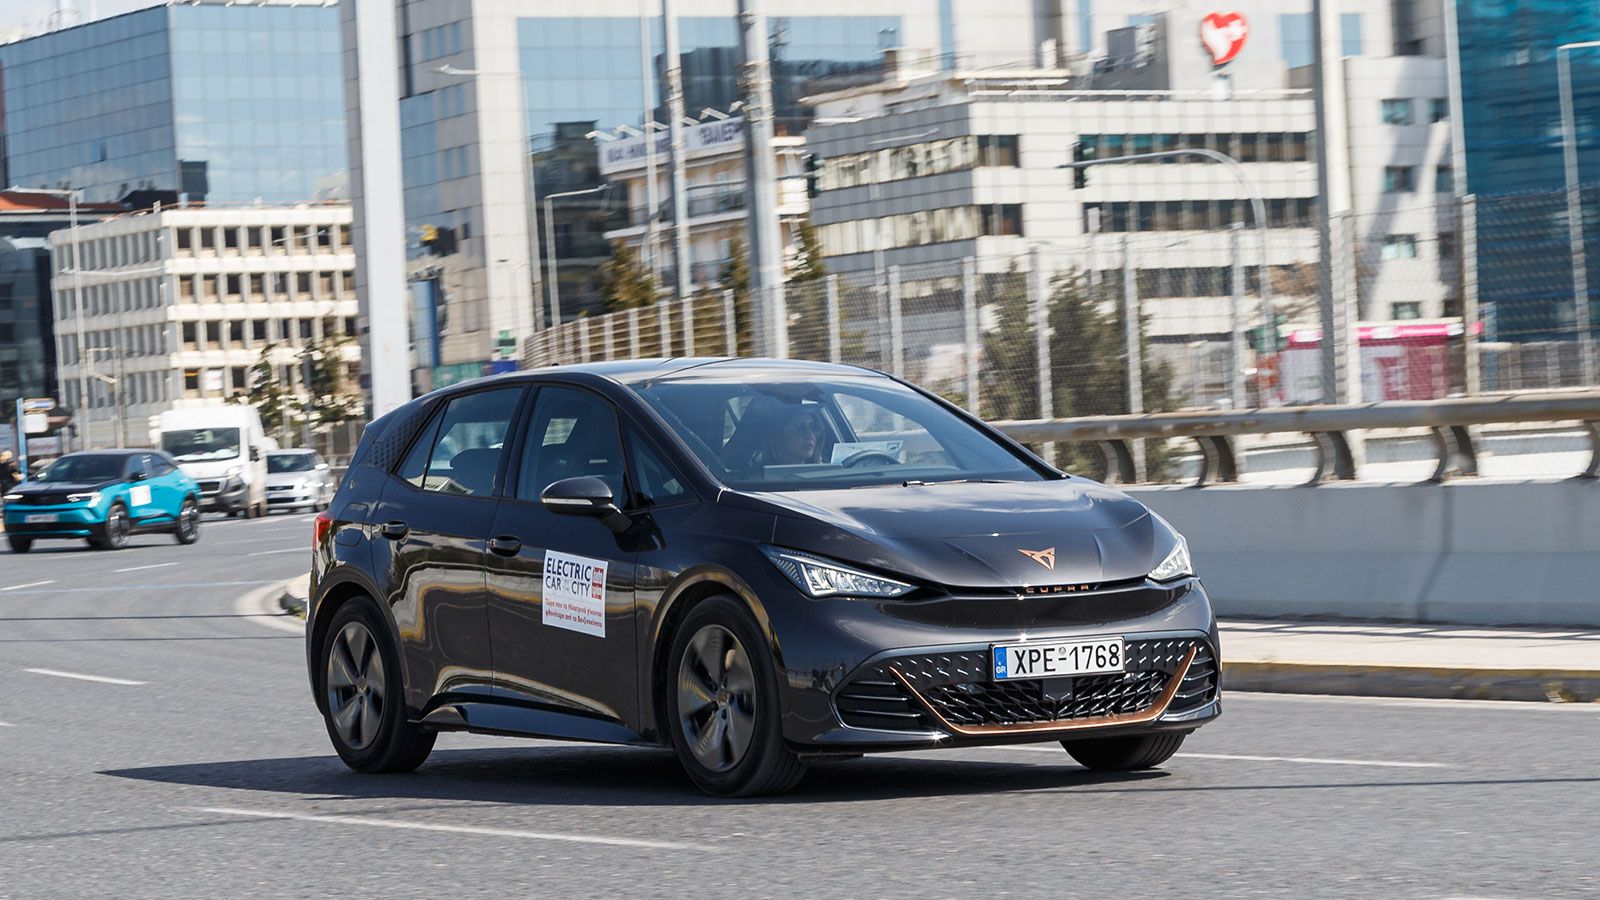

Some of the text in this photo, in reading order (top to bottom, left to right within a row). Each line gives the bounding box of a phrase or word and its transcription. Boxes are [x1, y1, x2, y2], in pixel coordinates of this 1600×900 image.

[546, 557, 592, 582] ELECTRIC
[545, 576, 562, 591] CAR
[571, 581, 590, 597] CITY
[1026, 584, 1089, 594] CUPRA
[995, 665, 1007, 674] GR
